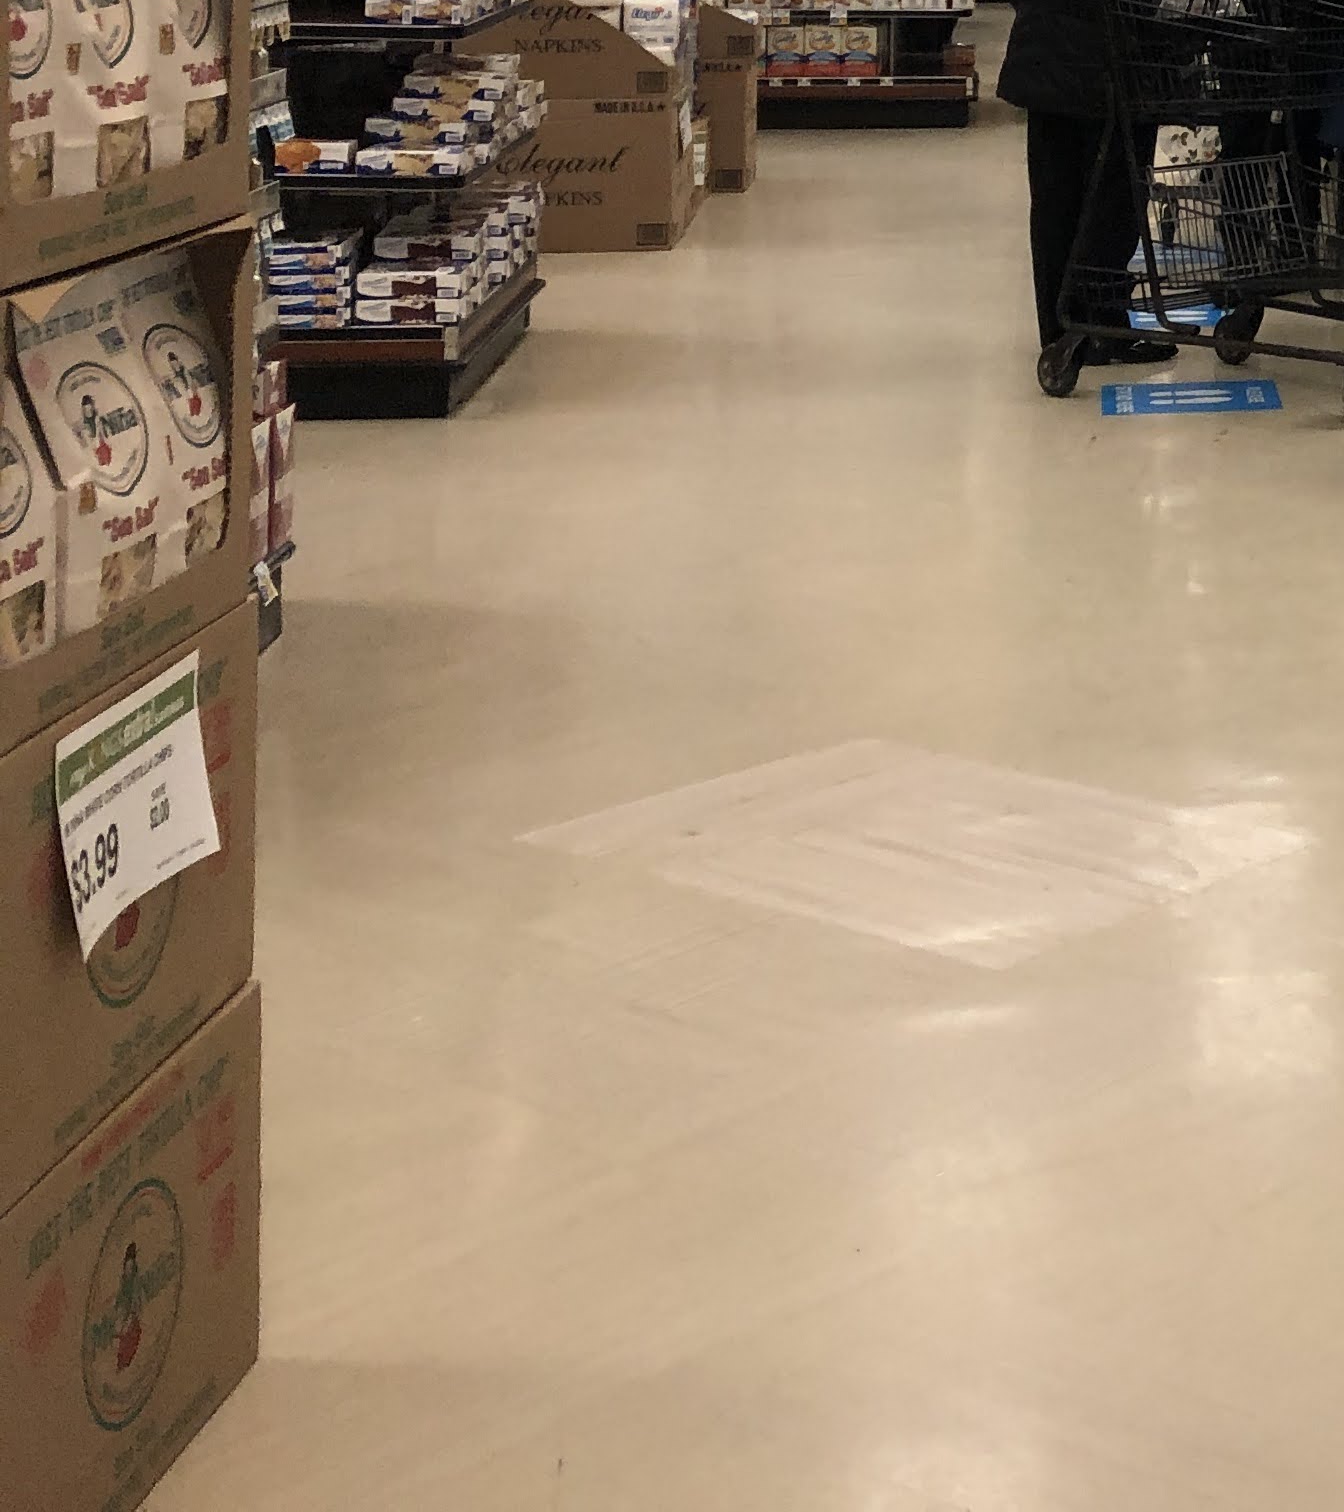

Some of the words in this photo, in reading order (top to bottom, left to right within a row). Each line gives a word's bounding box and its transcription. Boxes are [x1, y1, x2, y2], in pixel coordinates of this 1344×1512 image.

[514, 39, 605, 53] NAPKINS
[496, 143, 631, 185] Elegant
[544, 191, 603, 207] PKINS
[69, 822, 120, 914] $3.99
